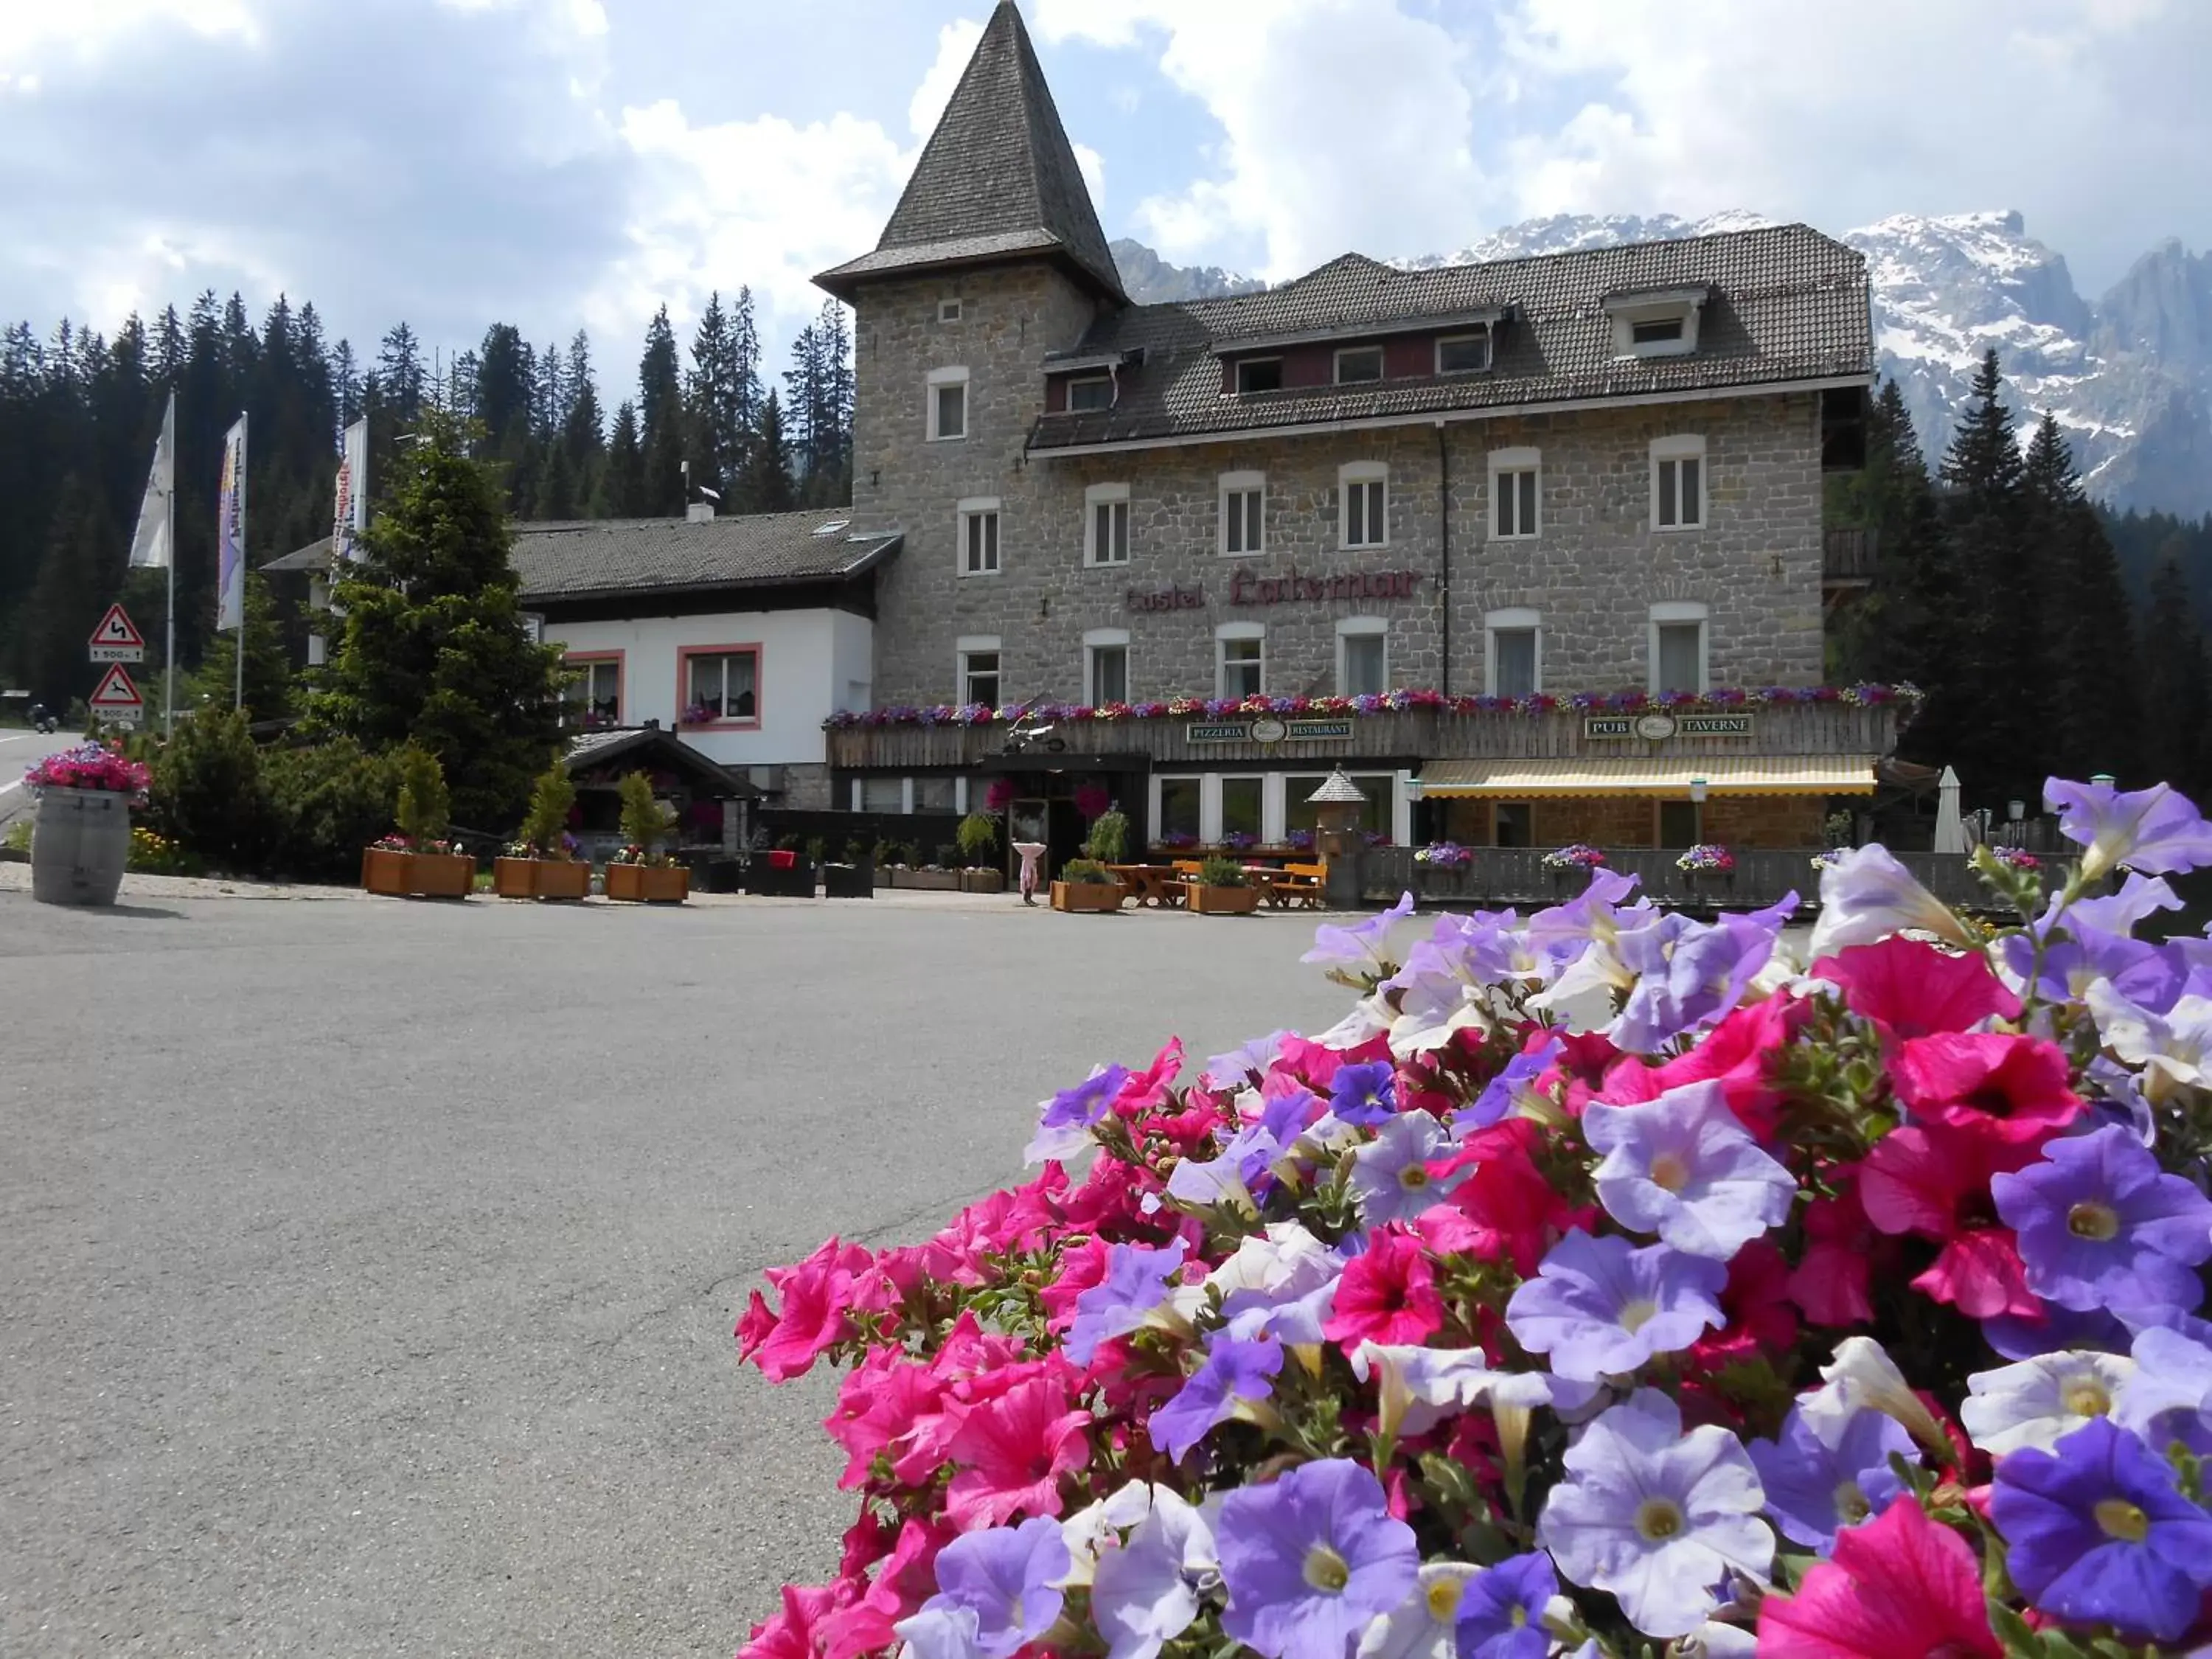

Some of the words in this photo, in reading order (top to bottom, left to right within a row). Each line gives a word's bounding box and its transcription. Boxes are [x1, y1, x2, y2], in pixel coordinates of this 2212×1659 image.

[1194, 726, 1244, 737] PIZZERIA
[1291, 724, 1347, 736] RESTAURANT
[1593, 723, 1627, 733] PUB
[1684, 719, 1747, 731] TAVERNE
